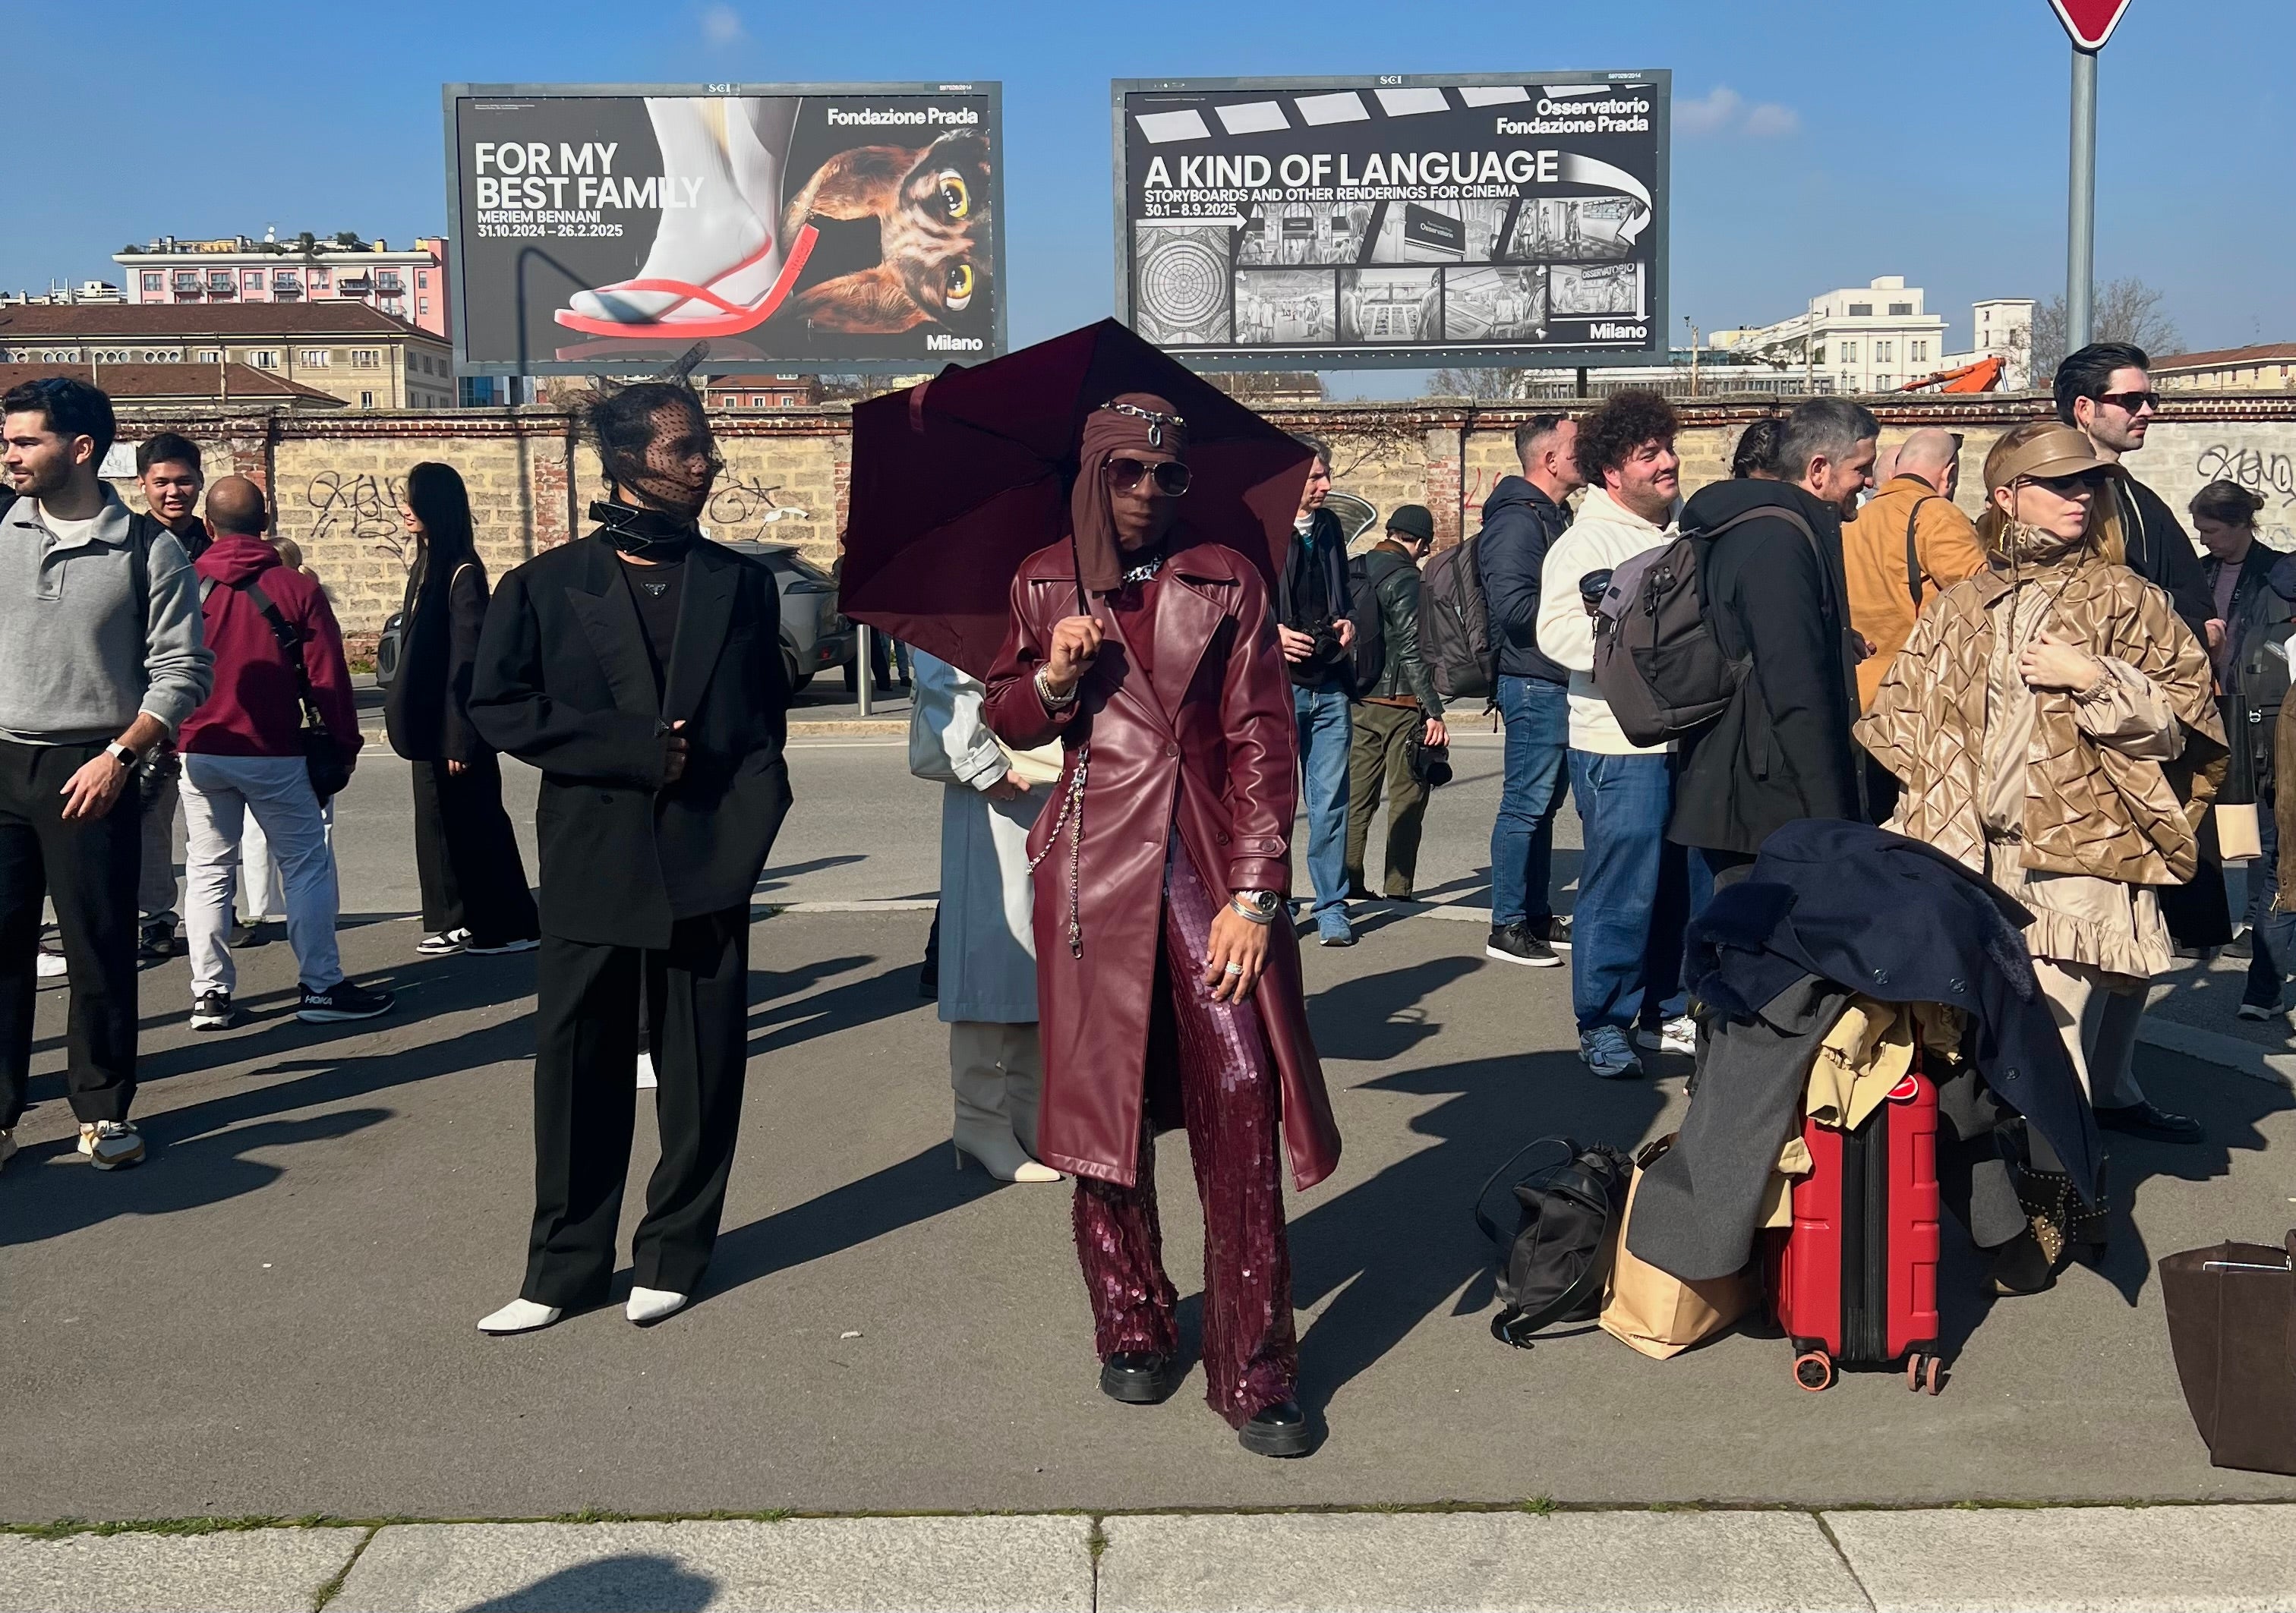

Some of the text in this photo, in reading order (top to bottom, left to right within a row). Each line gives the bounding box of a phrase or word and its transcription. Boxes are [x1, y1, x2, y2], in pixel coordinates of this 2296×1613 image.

[708, 83, 731, 93] SCI
[1380, 75, 1402, 85] SCI
[1536, 96, 1650, 116] Osservatorio
[828, 107, 979, 125] Fondazione Prada
[1496, 115, 1649, 134] Fondazione Prada
[475, 142, 619, 175] FOR MY
[1143, 150, 1559, 188] A KIND OF LANGUAGE
[476, 176, 705, 210] BEST FAMILY
[1144, 184, 1520, 203] STORYBOARDS AND OTHER RENDERINGS FOR CINEMA
[477, 210, 601, 223] MERIEM BENNANI
[1590, 322, 1648, 339] Milano
[926, 334, 983, 351] Milano
[304, 994, 333, 1006] HOKA
